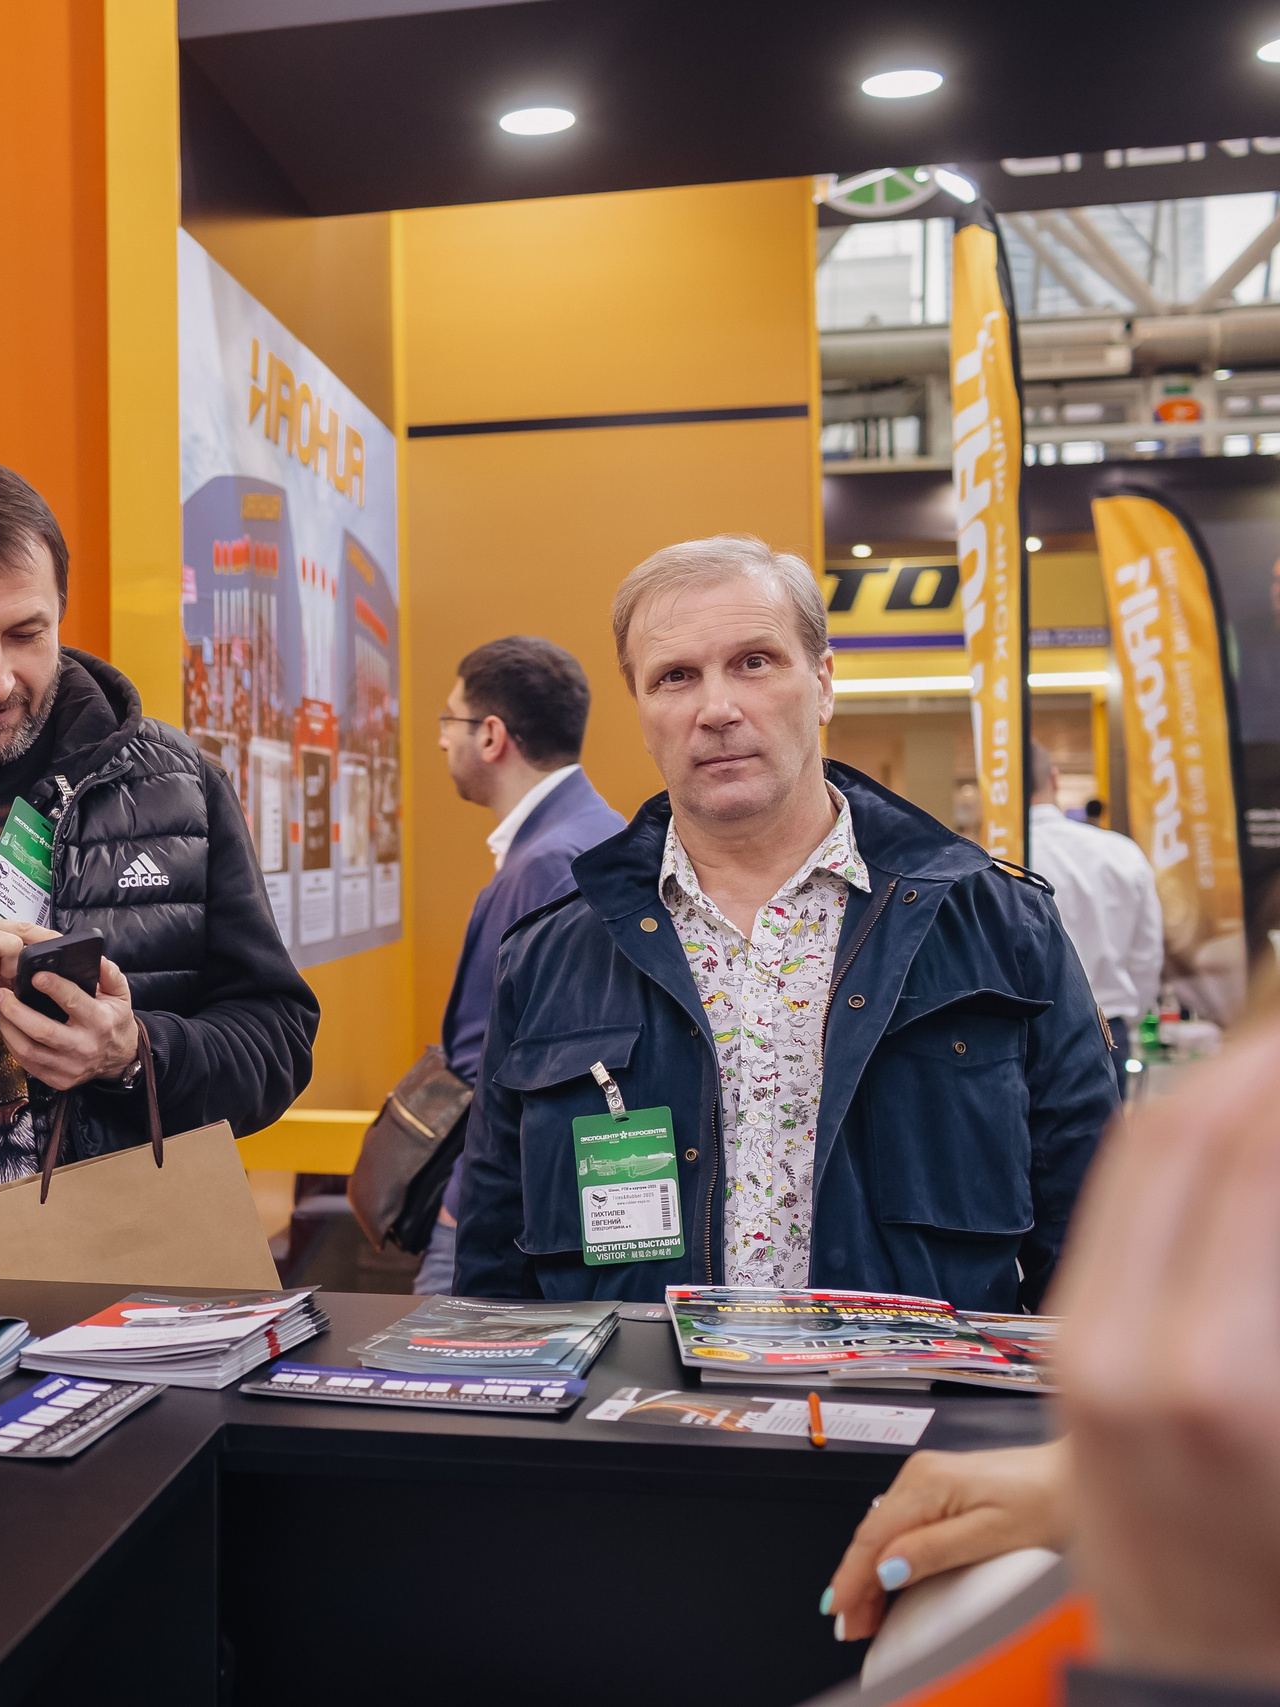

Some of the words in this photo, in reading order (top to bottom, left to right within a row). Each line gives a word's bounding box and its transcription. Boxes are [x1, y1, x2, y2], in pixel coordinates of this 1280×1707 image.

[118, 873, 169, 888] adidas
[628, 1128, 666, 1136] EXPOCENTRE
[591, 1217, 621, 1226] ЕВГЕНИЙ
[586, 1243, 637, 1253] ПОСЕТИТЕЛЬ
[638, 1238, 681, 1248] ВЫСТАВКИ
[596, 1252, 626, 1260] VISITOR
[717, 1305, 829, 1317] ЦЕННОСТИ
